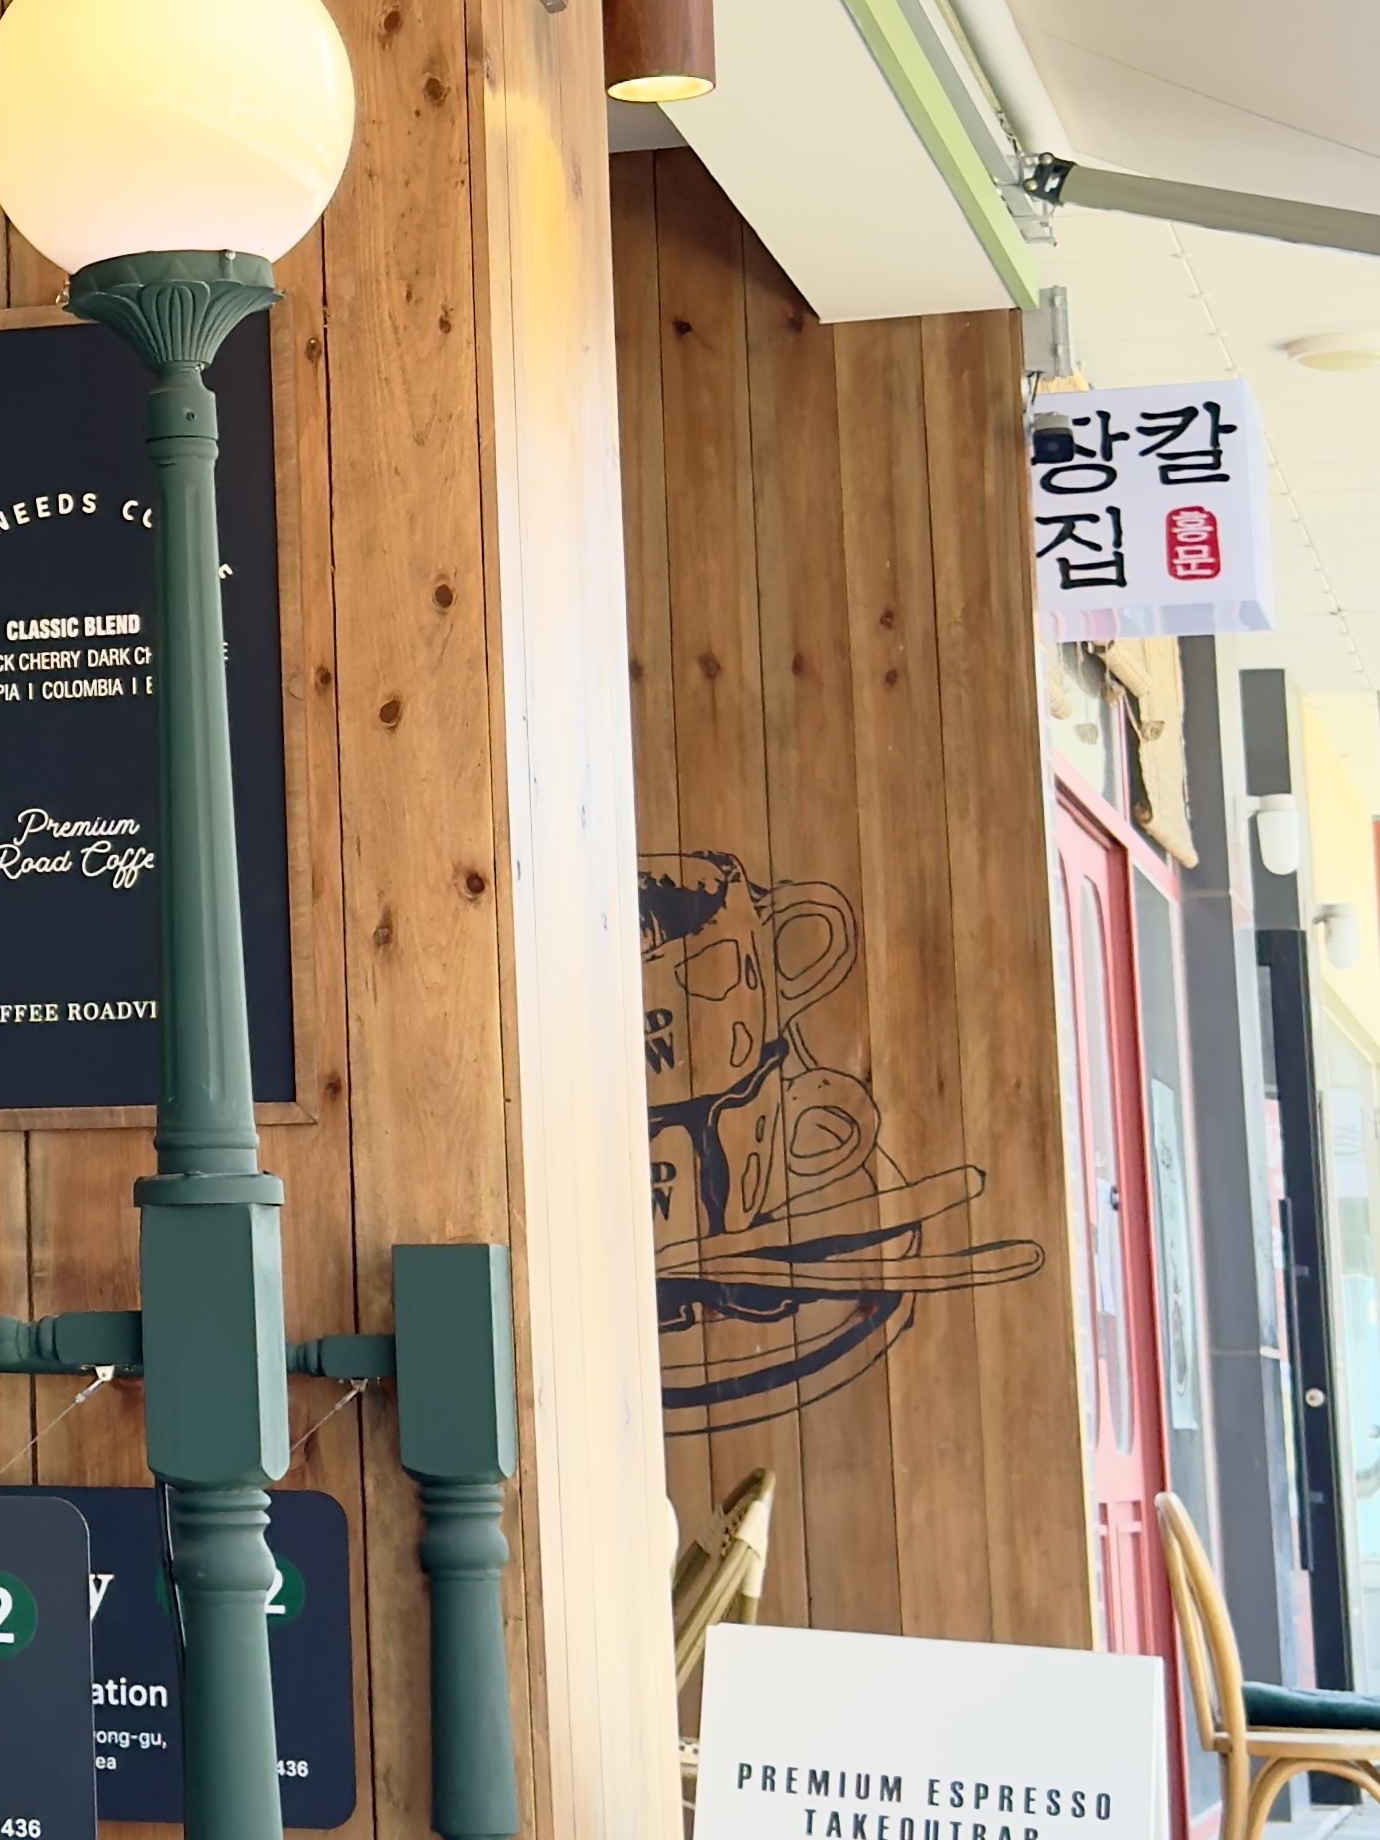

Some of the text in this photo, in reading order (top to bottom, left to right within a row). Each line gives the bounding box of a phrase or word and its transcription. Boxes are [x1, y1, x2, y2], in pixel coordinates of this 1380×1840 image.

[1035, 506, 1127, 589] 집
[6, 614, 141, 641] CLASSIC BLEND
[18, 650, 81, 672] CHERRY
[87, 647, 131, 669] DARK
[42, 677, 124, 700] COLOMBIA
[13, 808, 140, 846] Premium
[80, 840, 155, 889] Coffe
[67, 1001, 157, 1021] ROADVI
[92, 1677, 168, 1708] ation
[95, 1730, 168, 1750] ong-gu,
[737, 1762, 1111, 1821] PREMIUM ESPRESSO
